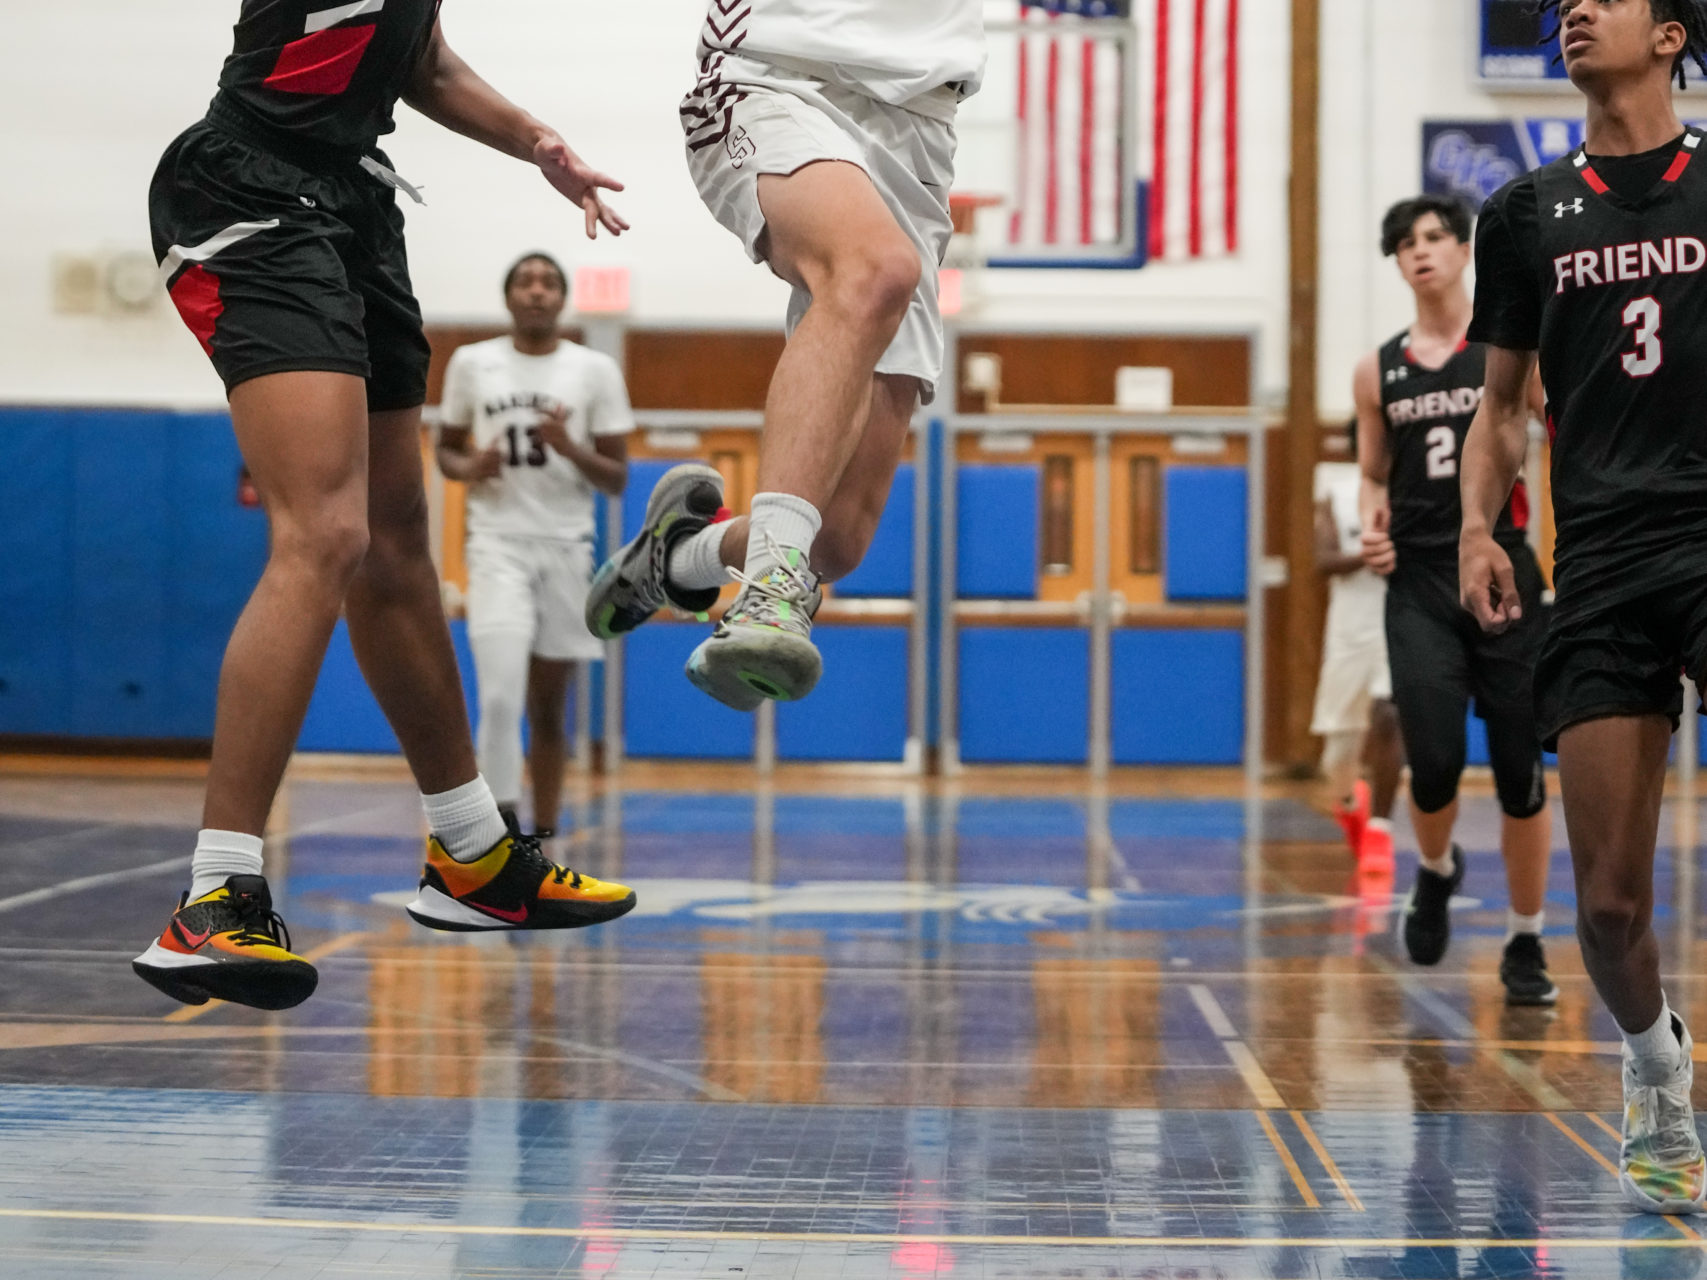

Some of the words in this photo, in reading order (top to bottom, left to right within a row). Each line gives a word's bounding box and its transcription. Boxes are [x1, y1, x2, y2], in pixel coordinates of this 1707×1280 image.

[1553, 236, 1707, 295] FRIEND
[1620, 294, 1664, 379] 3
[1425, 426, 1457, 480] 2
